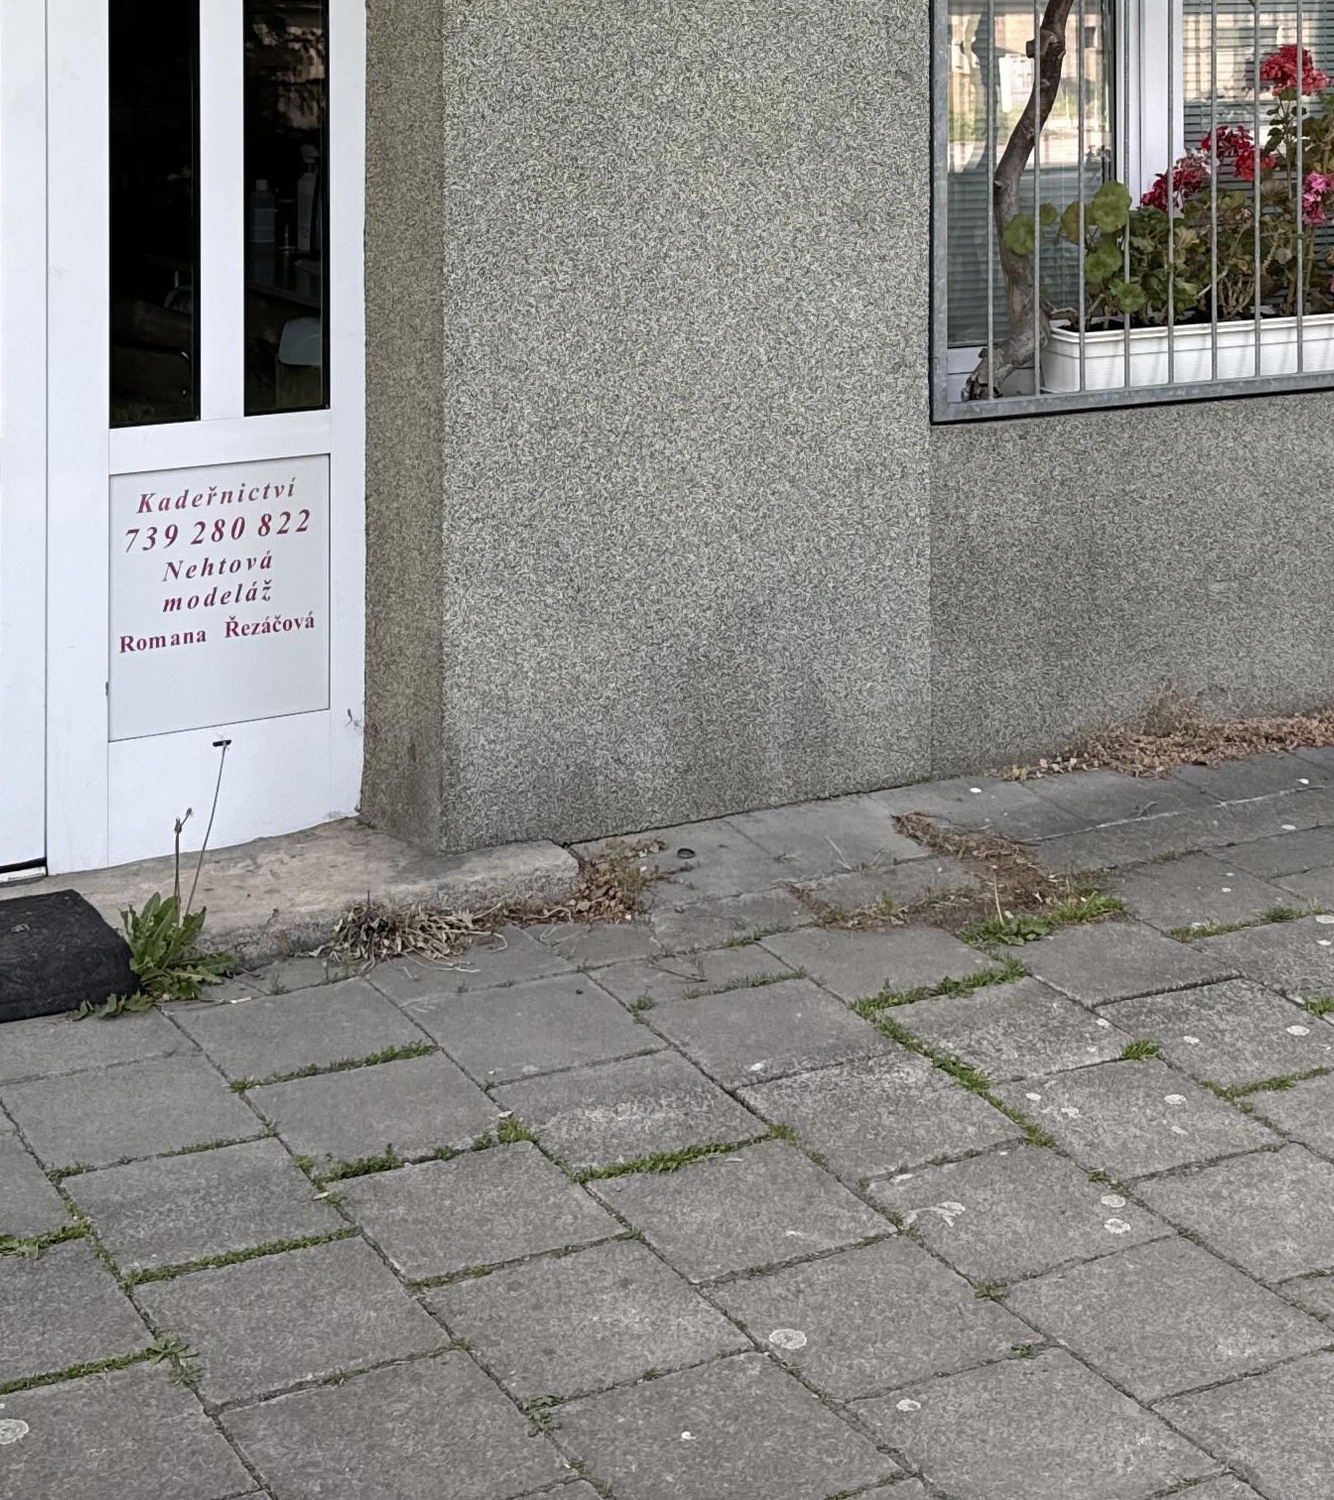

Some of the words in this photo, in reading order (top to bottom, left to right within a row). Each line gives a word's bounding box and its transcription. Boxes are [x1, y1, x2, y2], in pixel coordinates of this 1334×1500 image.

[136, 477, 296, 514] Kadeřnictví
[125, 524, 179, 553] 739
[190, 516, 246, 545] 280
[257, 509, 310, 537] 822
[162, 550, 273, 582] Nehtová
[162, 579, 272, 613] modeláž
[119, 630, 206, 653] Romana
[225, 611, 315, 638] Řezáčová
